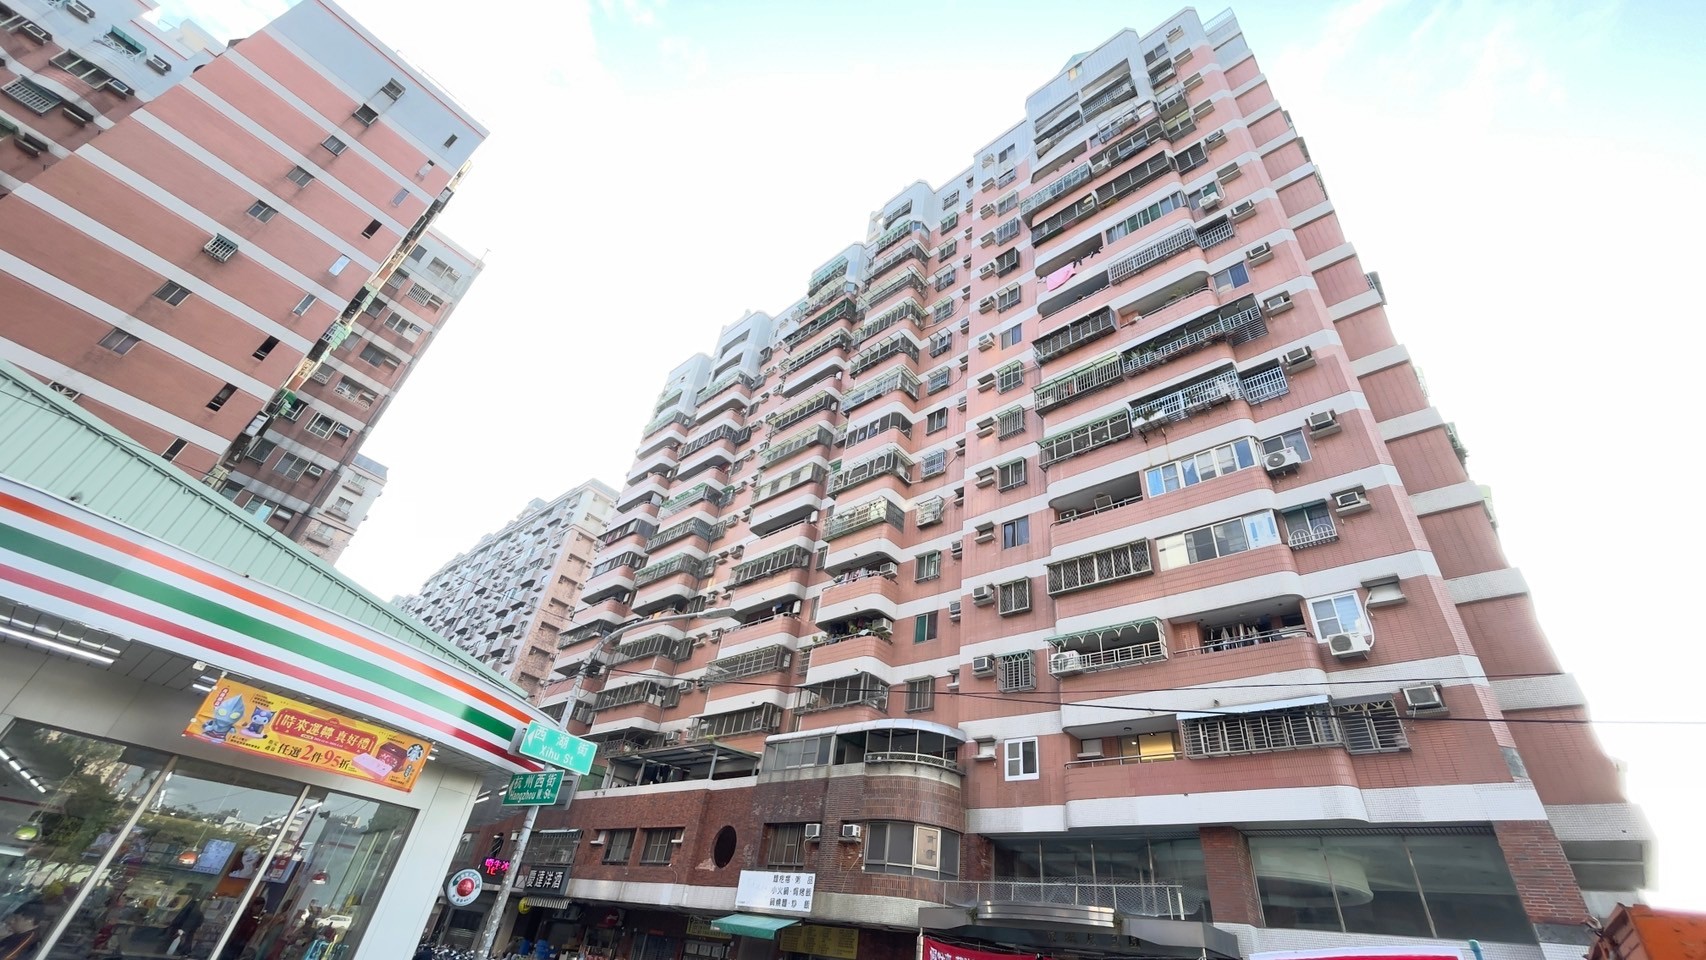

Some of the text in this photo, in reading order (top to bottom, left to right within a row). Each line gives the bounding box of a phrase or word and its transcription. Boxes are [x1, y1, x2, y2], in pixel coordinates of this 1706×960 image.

[280, 714, 335, 740] 時來運轉
[336, 731, 371, 752] 真好禮
[534, 726, 589, 757] 西湖街
[539, 745, 560, 760] Xihu
[513, 773, 557, 789] 杭州西街
[508, 790, 536, 803] Hangzhou
